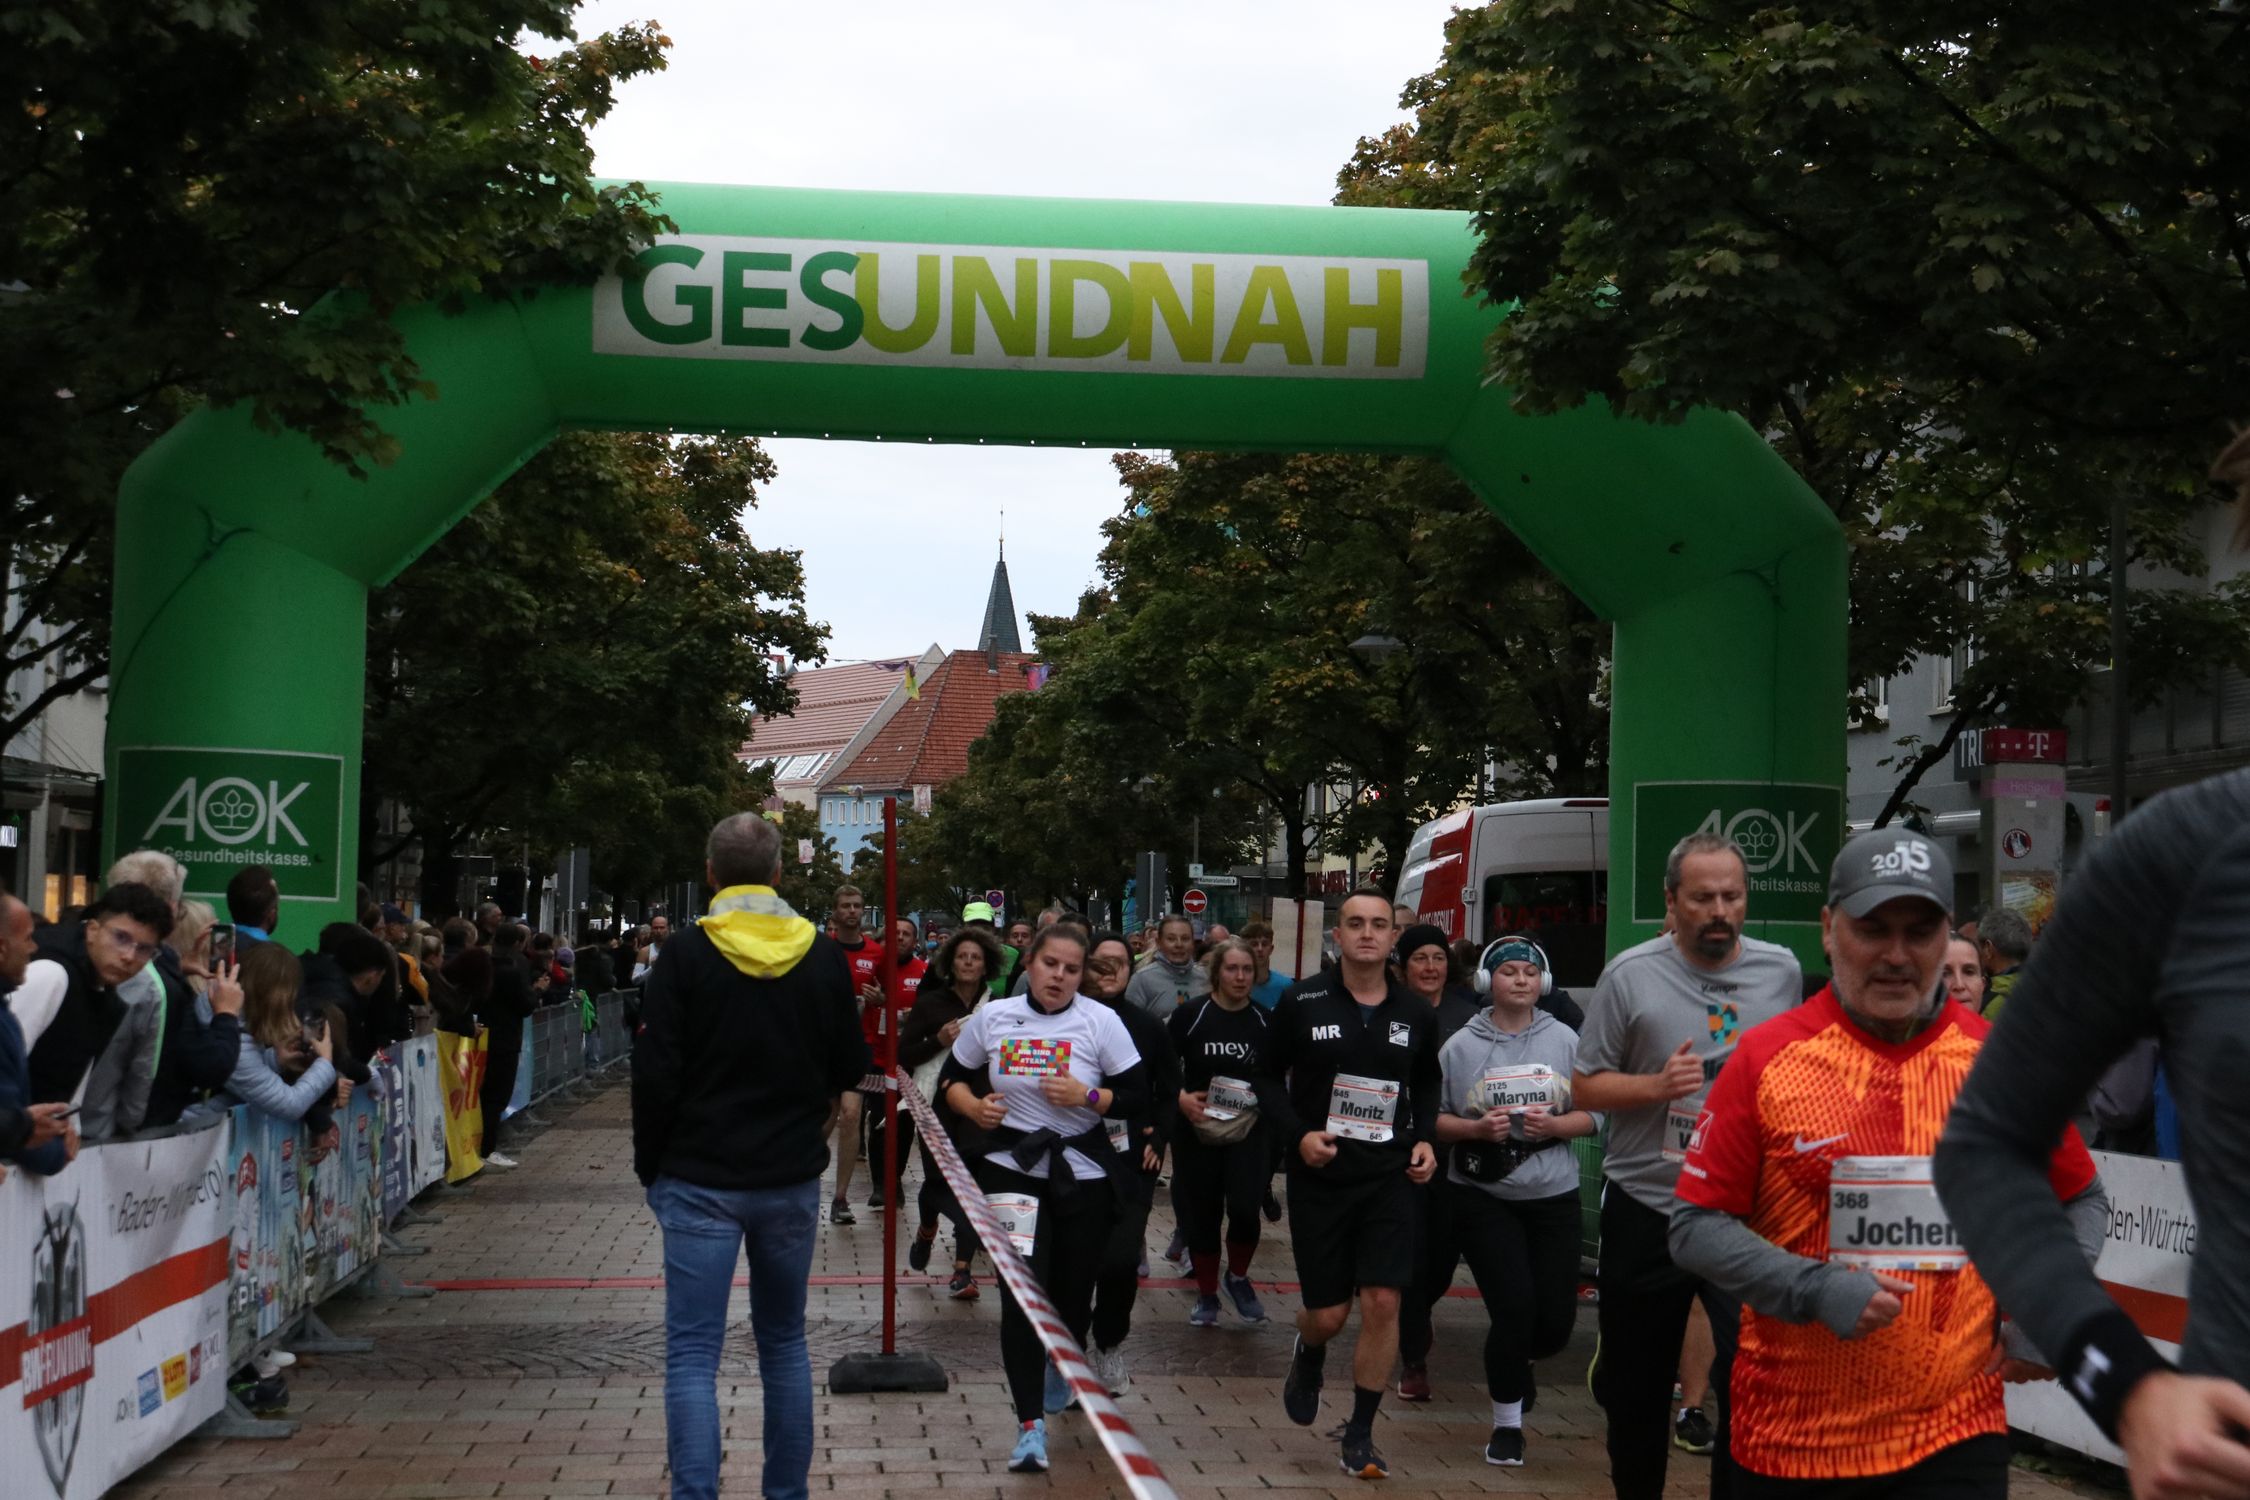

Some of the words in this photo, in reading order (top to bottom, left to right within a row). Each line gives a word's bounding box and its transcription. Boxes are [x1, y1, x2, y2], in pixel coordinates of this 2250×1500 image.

[621, 243, 1402, 368] GESUNDNAH
[142, 776, 311, 847] AOK
[1871, 840, 1931, 873] 2015
[1747, 877, 1823, 893] heitskasse.
[1297, 989, 1328, 1001] uhlsport
[1312, 1025, 1341, 1041] MR
[1204, 1042, 1249, 1059] mey
[1333, 1088, 1350, 1099] 645
[1487, 1081, 1508, 1091] 2125
[1493, 1091, 1547, 1106] Maryna
[1340, 1101, 1385, 1120] Moritz
[1369, 1132, 1383, 1141] 645
[1834, 1192, 1870, 1209] 368
